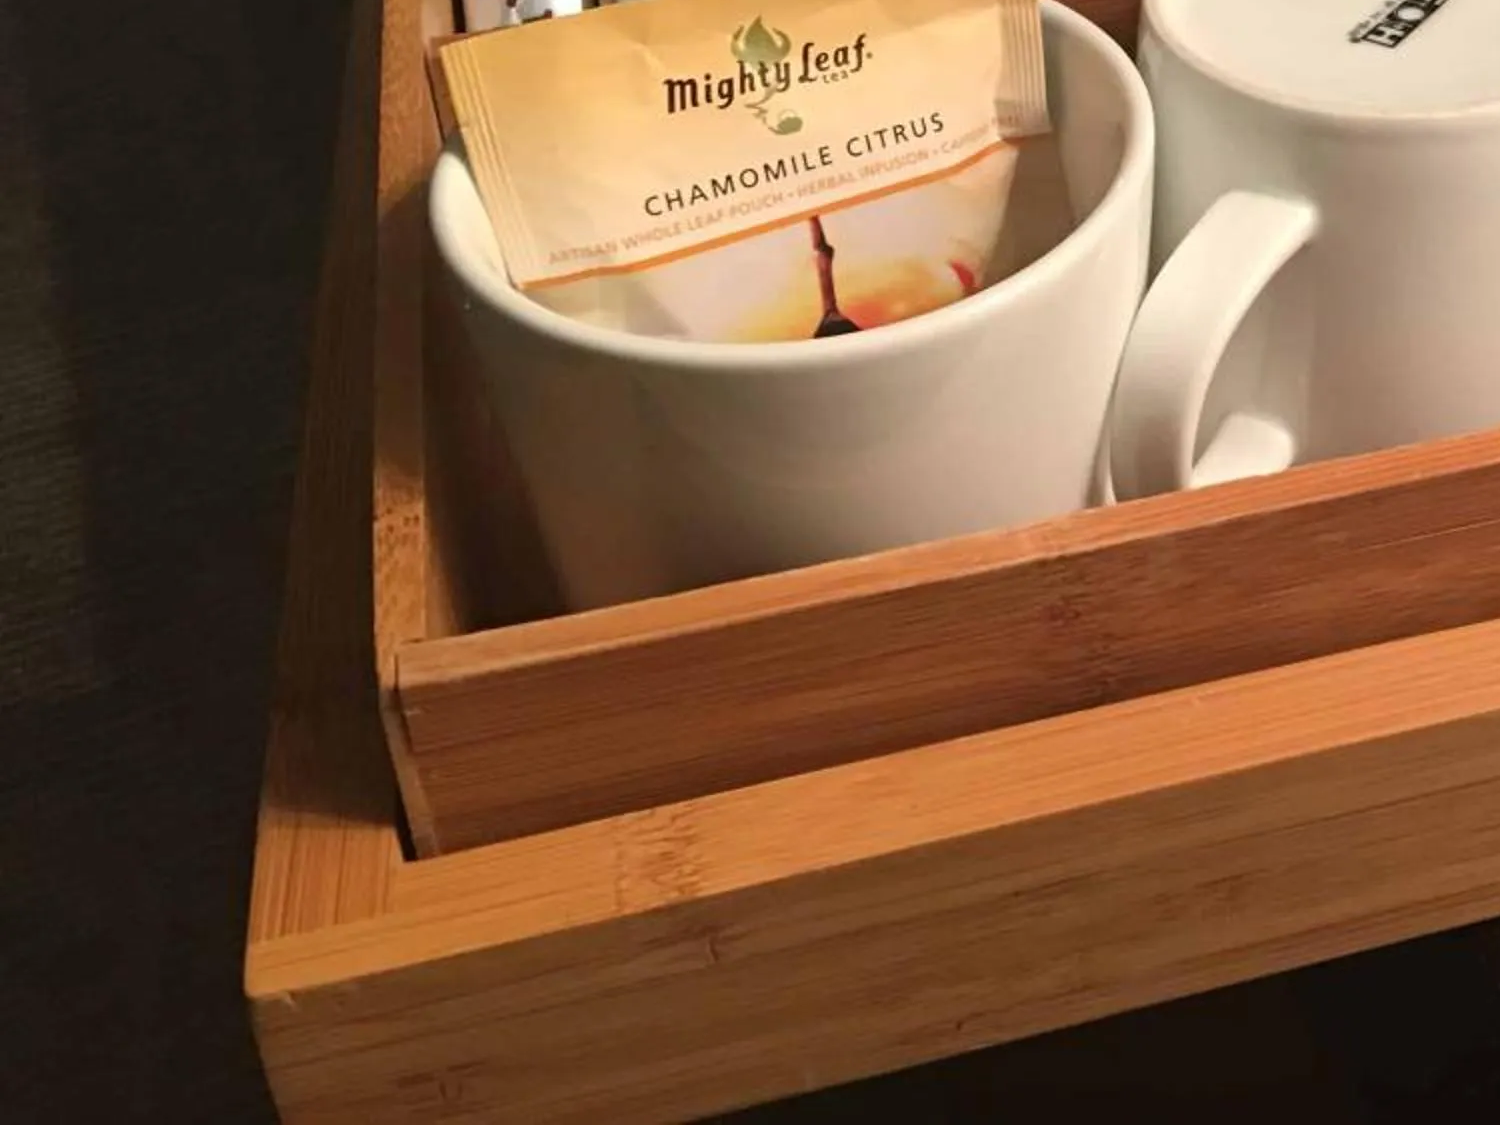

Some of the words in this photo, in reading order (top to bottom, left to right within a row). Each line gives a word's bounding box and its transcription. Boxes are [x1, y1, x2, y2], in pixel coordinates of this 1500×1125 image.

[664, 60, 791, 114] Mighty
[798, 33, 867, 83] Leaf
[822, 69, 849, 84] tea
[549, 240, 619, 266] ARTISAN
[622, 221, 684, 251] WHOLE
[687, 209, 725, 232] LEAF
[728, 190, 785, 217] POUCH
[796, 170, 857, 197] HERBAL
[859, 148, 931, 178] INFUSION
[643, 145, 834, 216] CHAMOMILE
[846, 111, 945, 158] CITRUS
